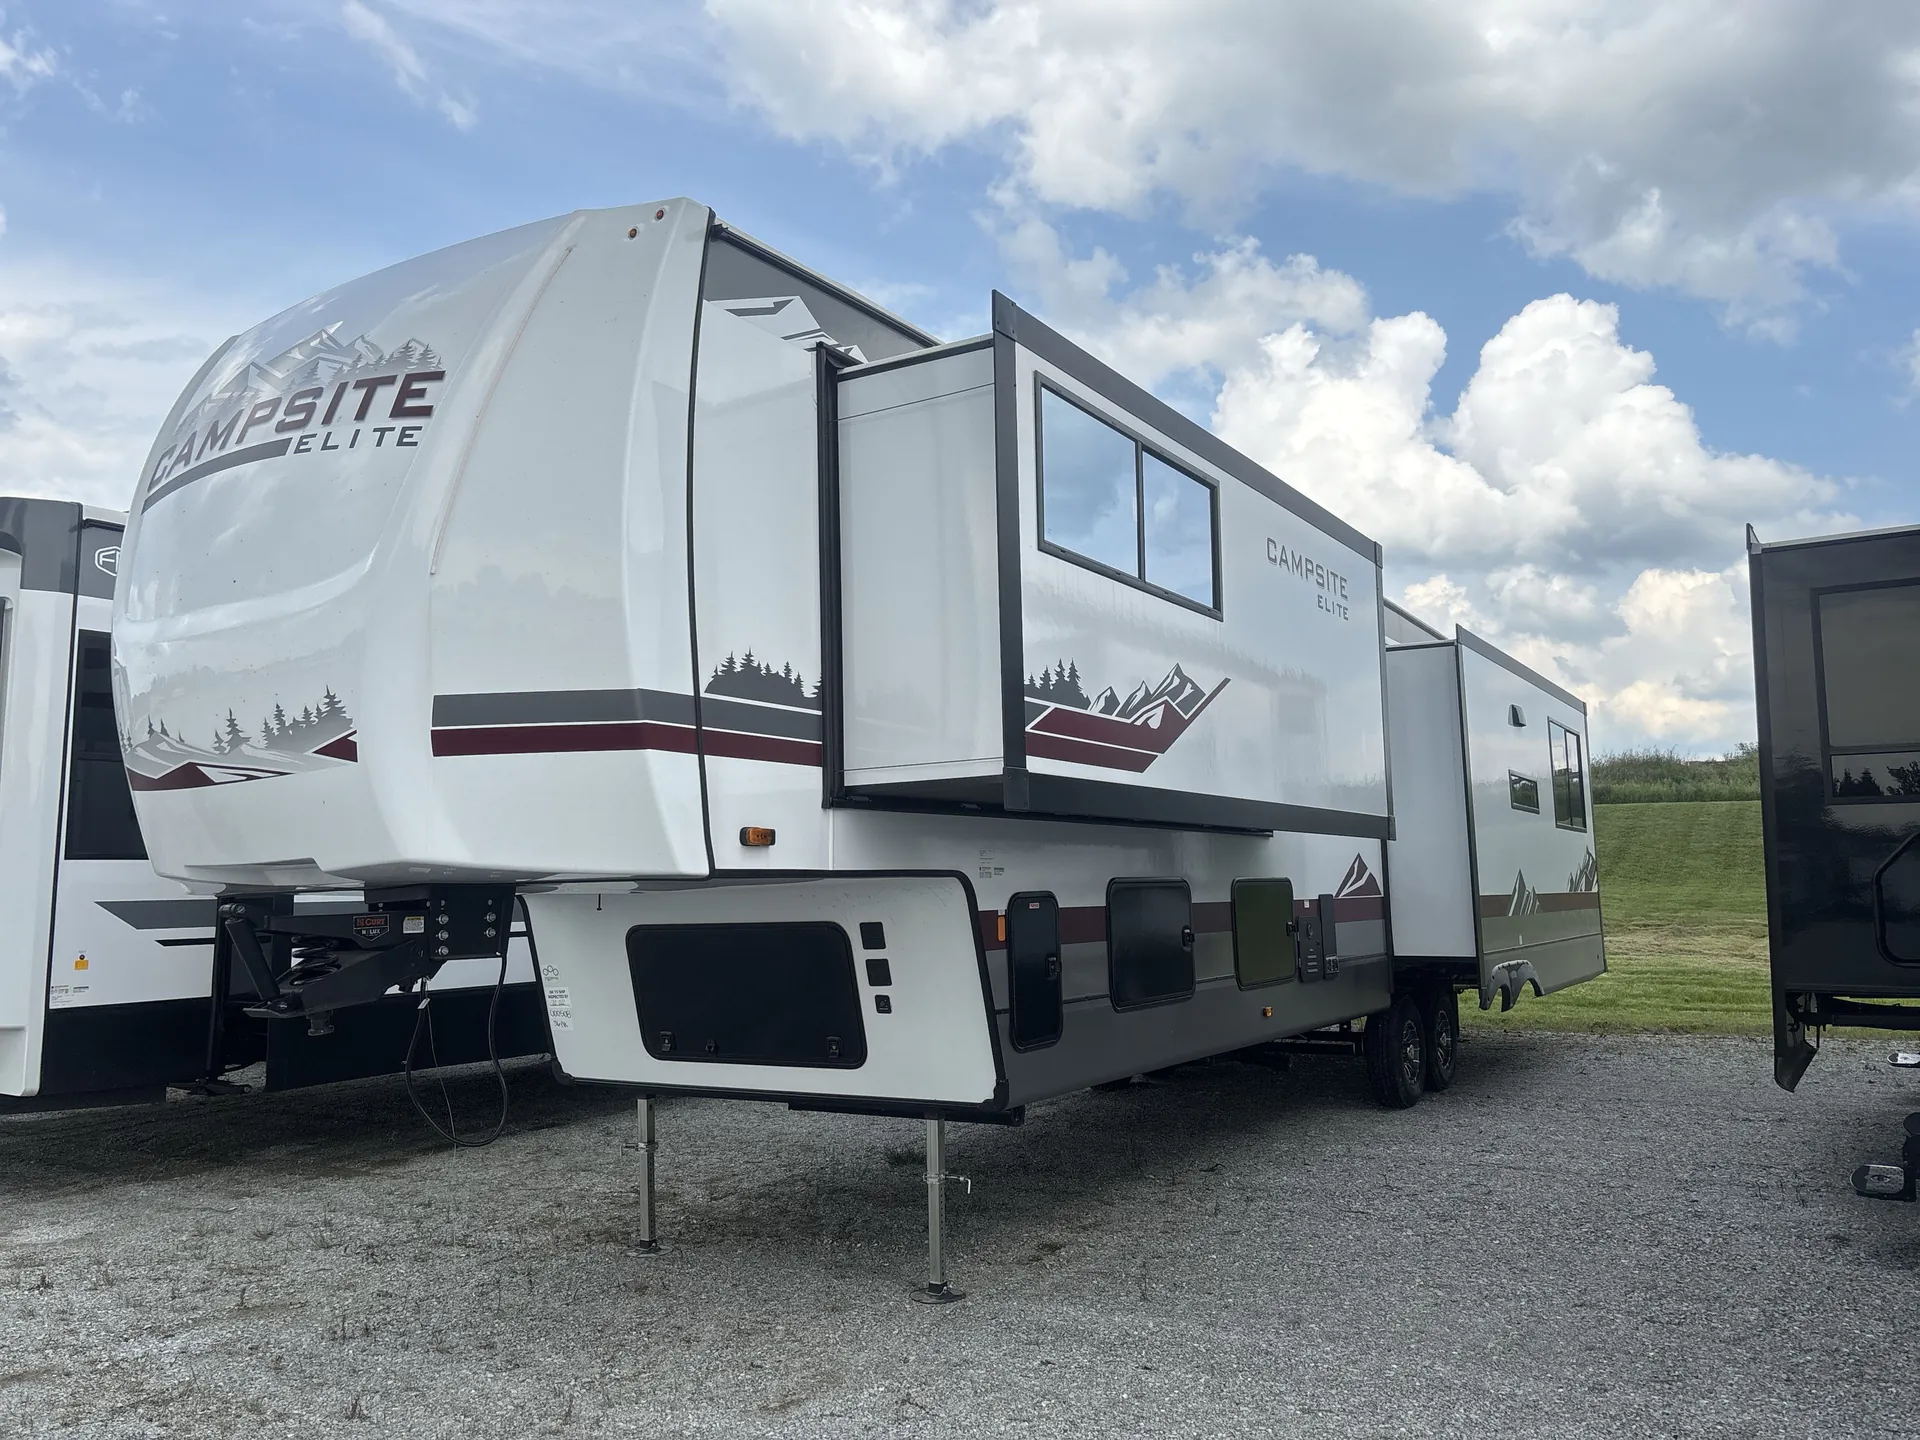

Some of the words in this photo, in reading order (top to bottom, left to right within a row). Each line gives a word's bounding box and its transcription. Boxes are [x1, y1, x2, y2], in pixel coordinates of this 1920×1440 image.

[147, 370, 446, 492] CAMPSITE
[293, 425, 423, 455] ELITE
[1266, 537, 1349, 601] CAMPSITE
[1317, 594, 1349, 621] ELITE
